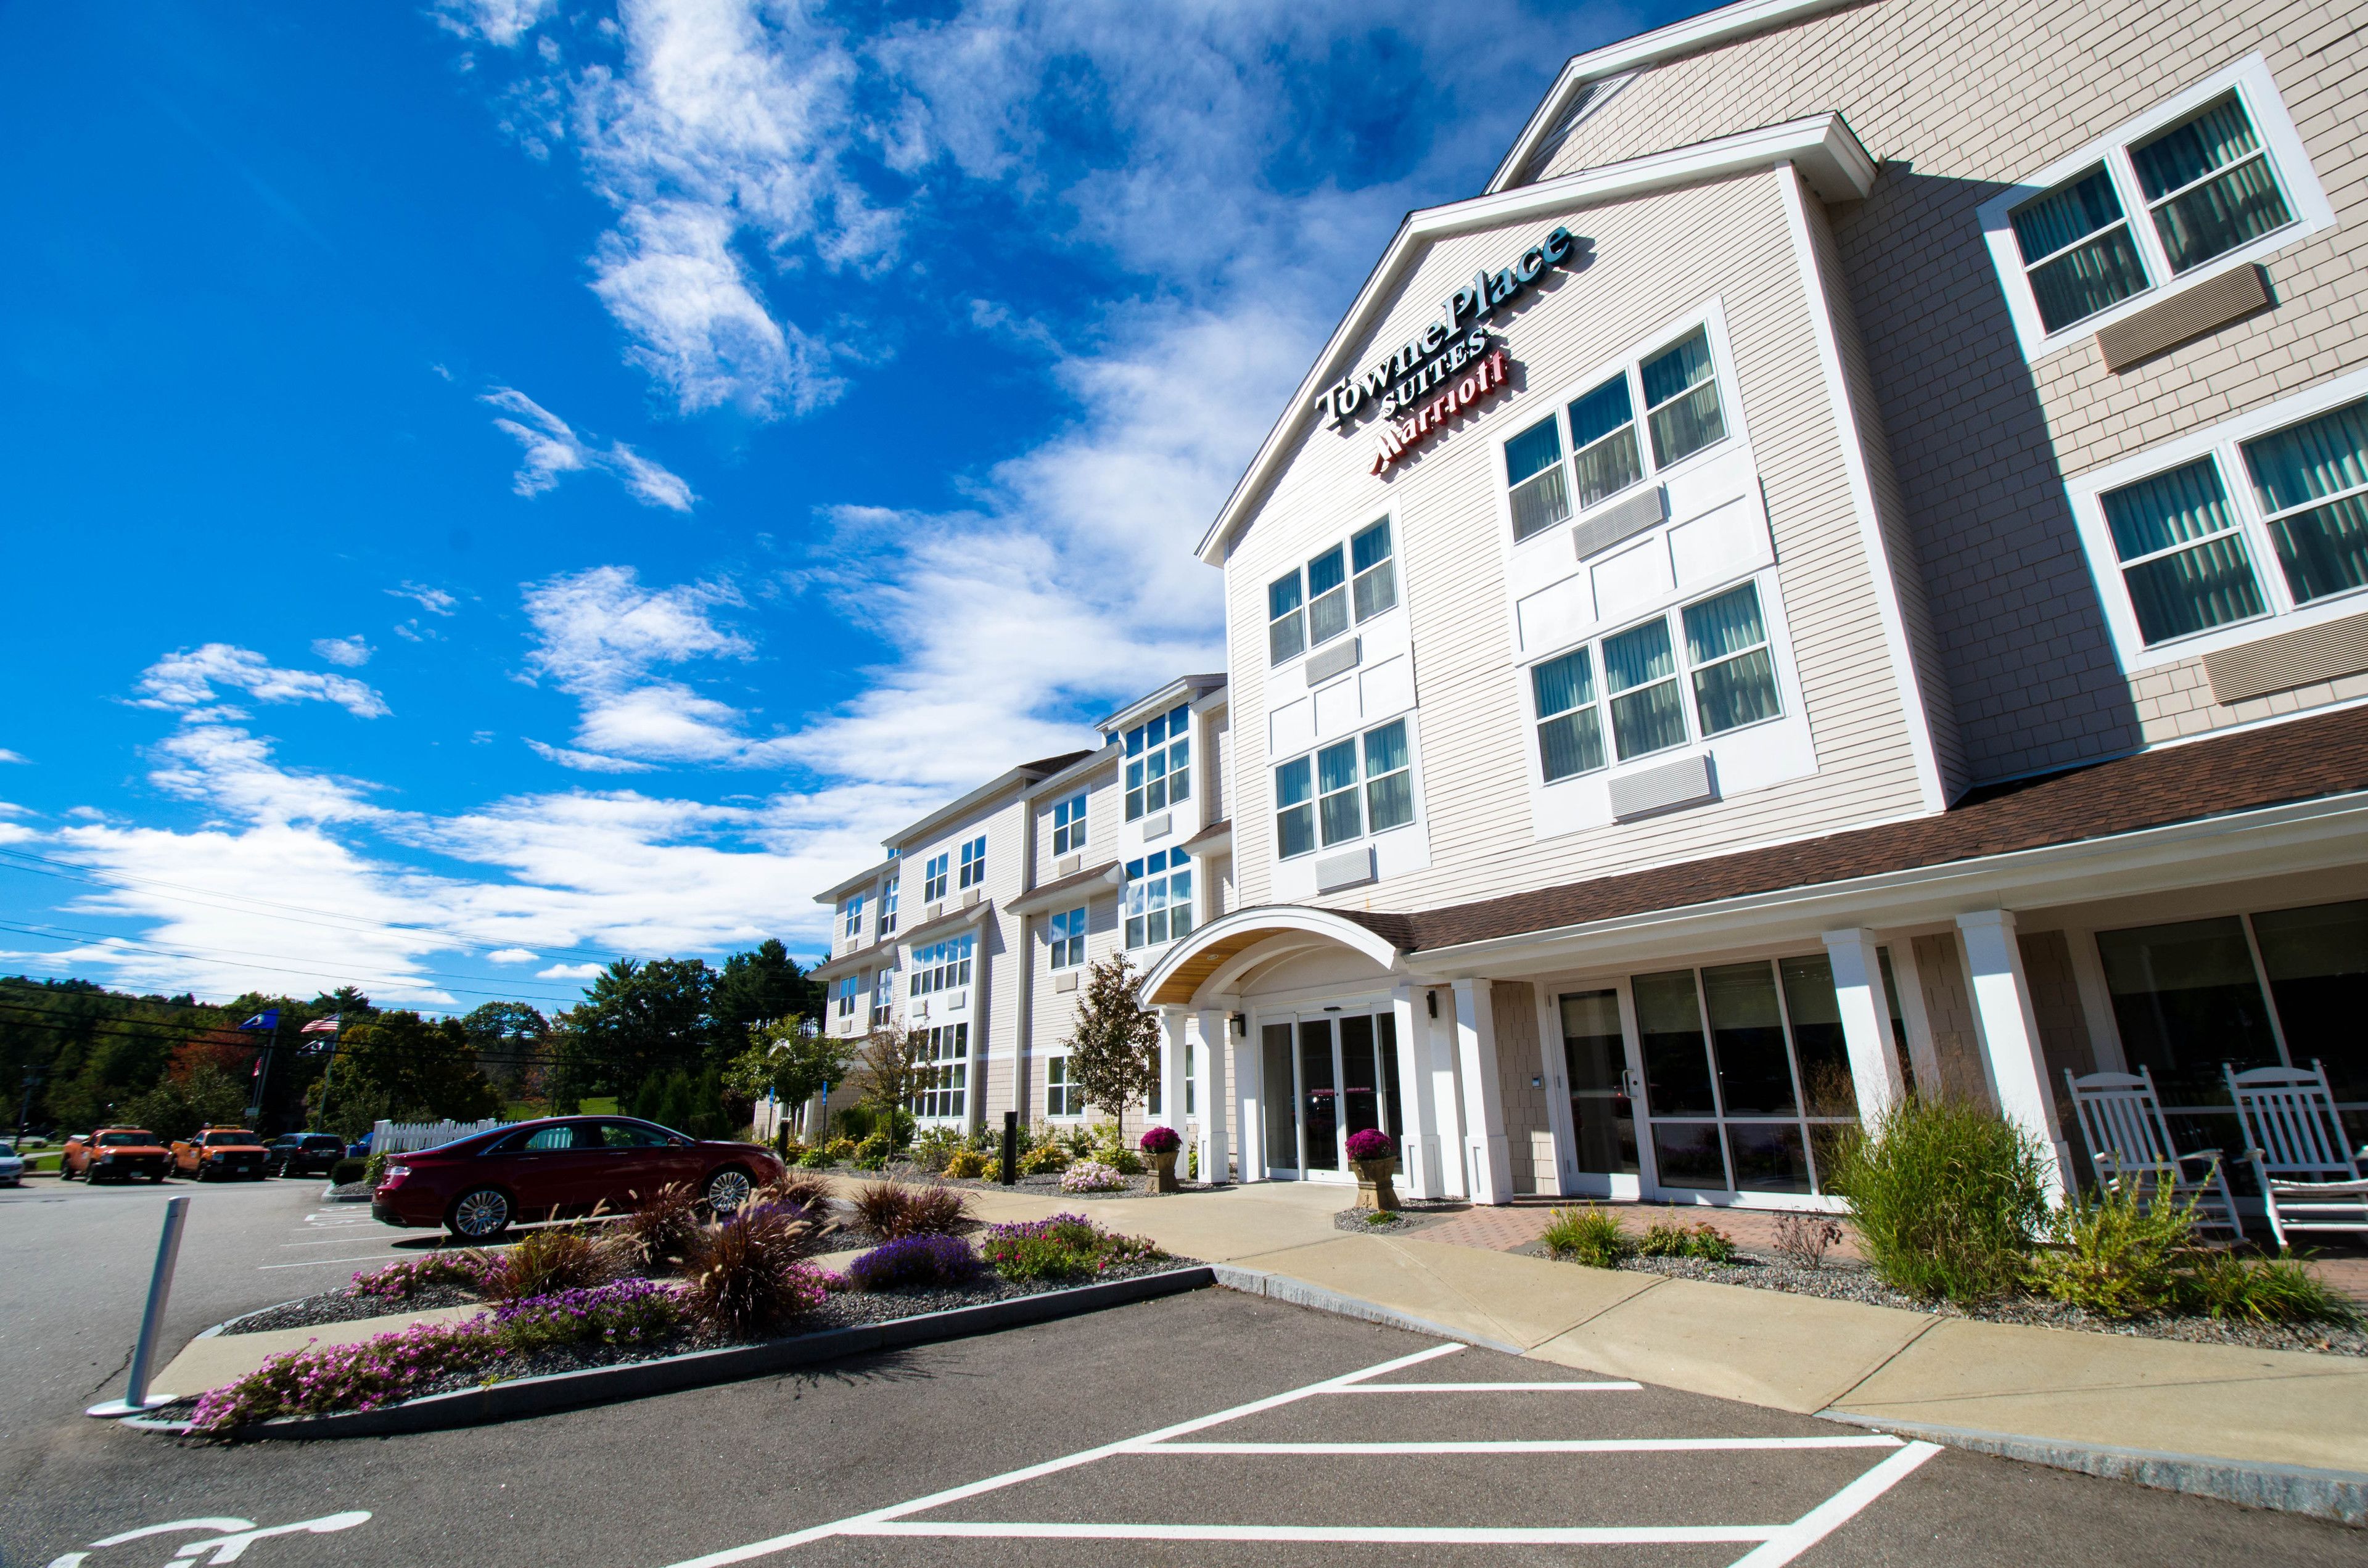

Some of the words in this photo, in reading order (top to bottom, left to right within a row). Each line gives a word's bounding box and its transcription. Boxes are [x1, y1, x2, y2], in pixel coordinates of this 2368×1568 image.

[1315, 226, 1573, 429] TownePlace
[1381, 327, 1489, 417] SUITES
[1368, 350, 1508, 475] Marriott
